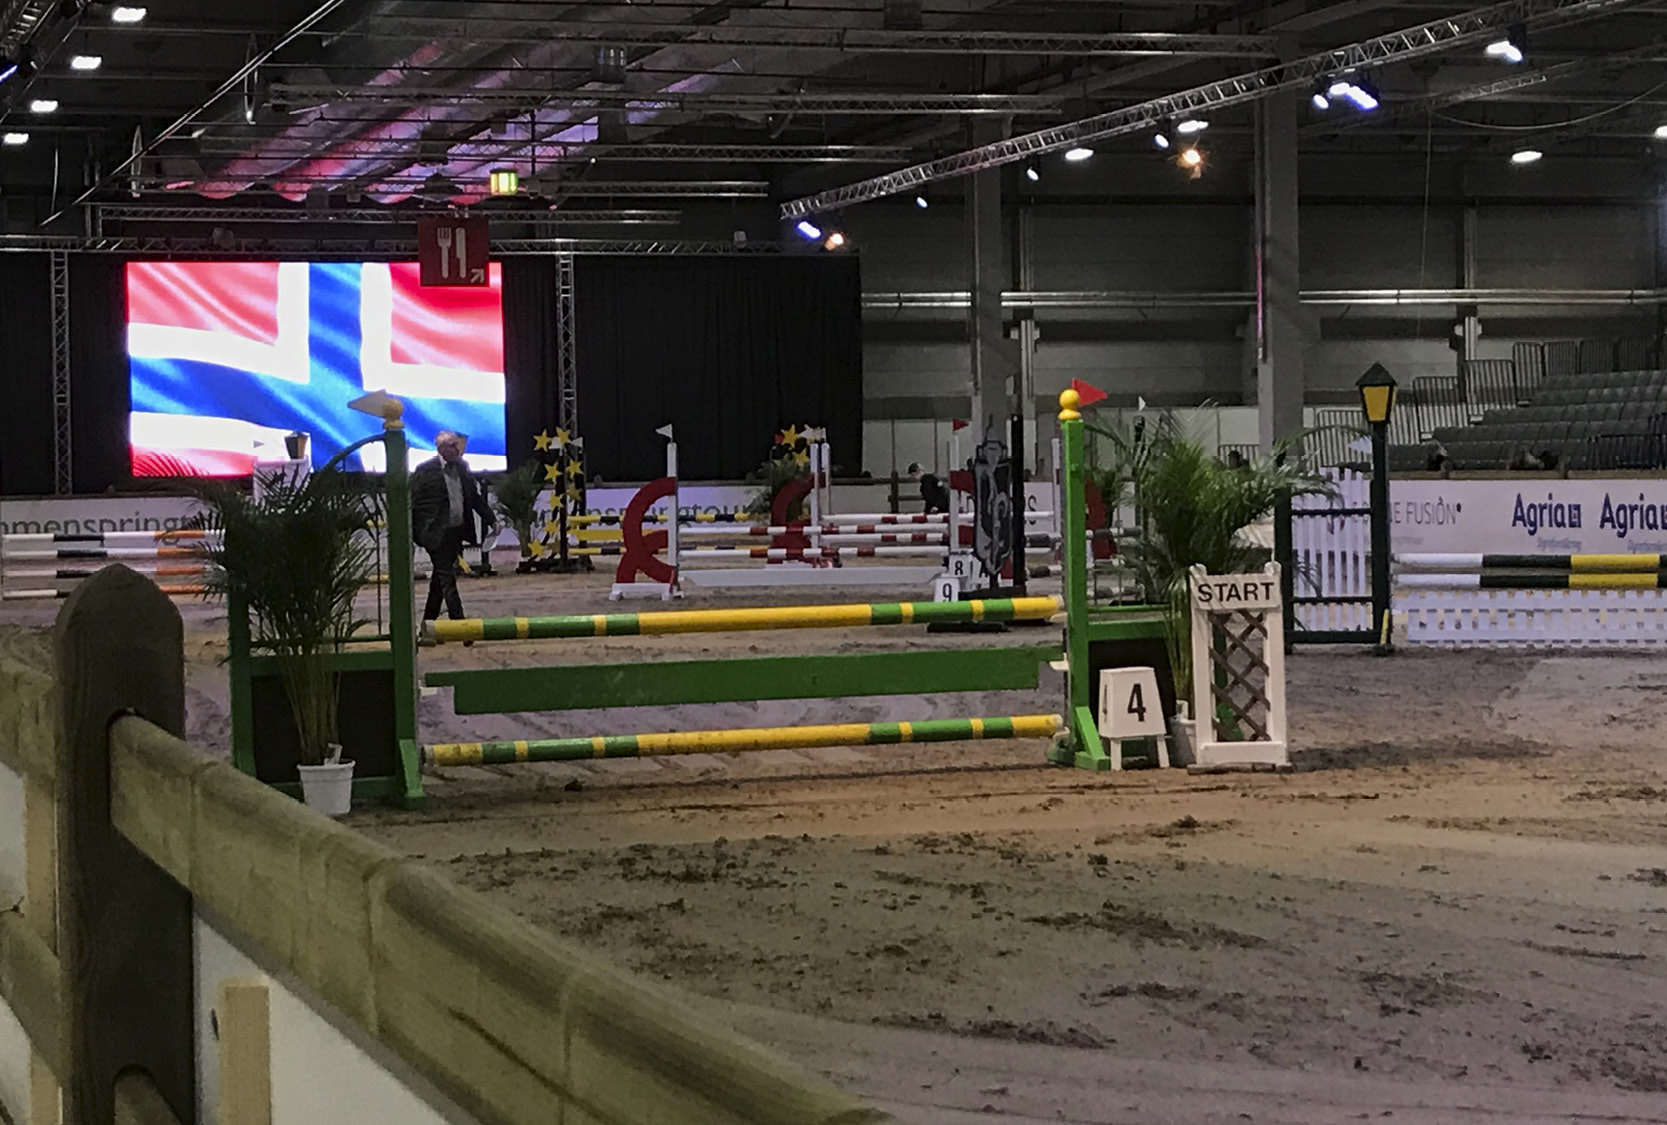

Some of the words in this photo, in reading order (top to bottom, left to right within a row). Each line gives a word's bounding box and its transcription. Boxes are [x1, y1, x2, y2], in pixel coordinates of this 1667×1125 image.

[1511, 492, 1566, 536] Agria
[1599, 492, 1659, 538] Agria
[942, 582, 952, 602] 9
[1197, 582, 1275, 602] START
[1127, 683, 1147, 722] 4
